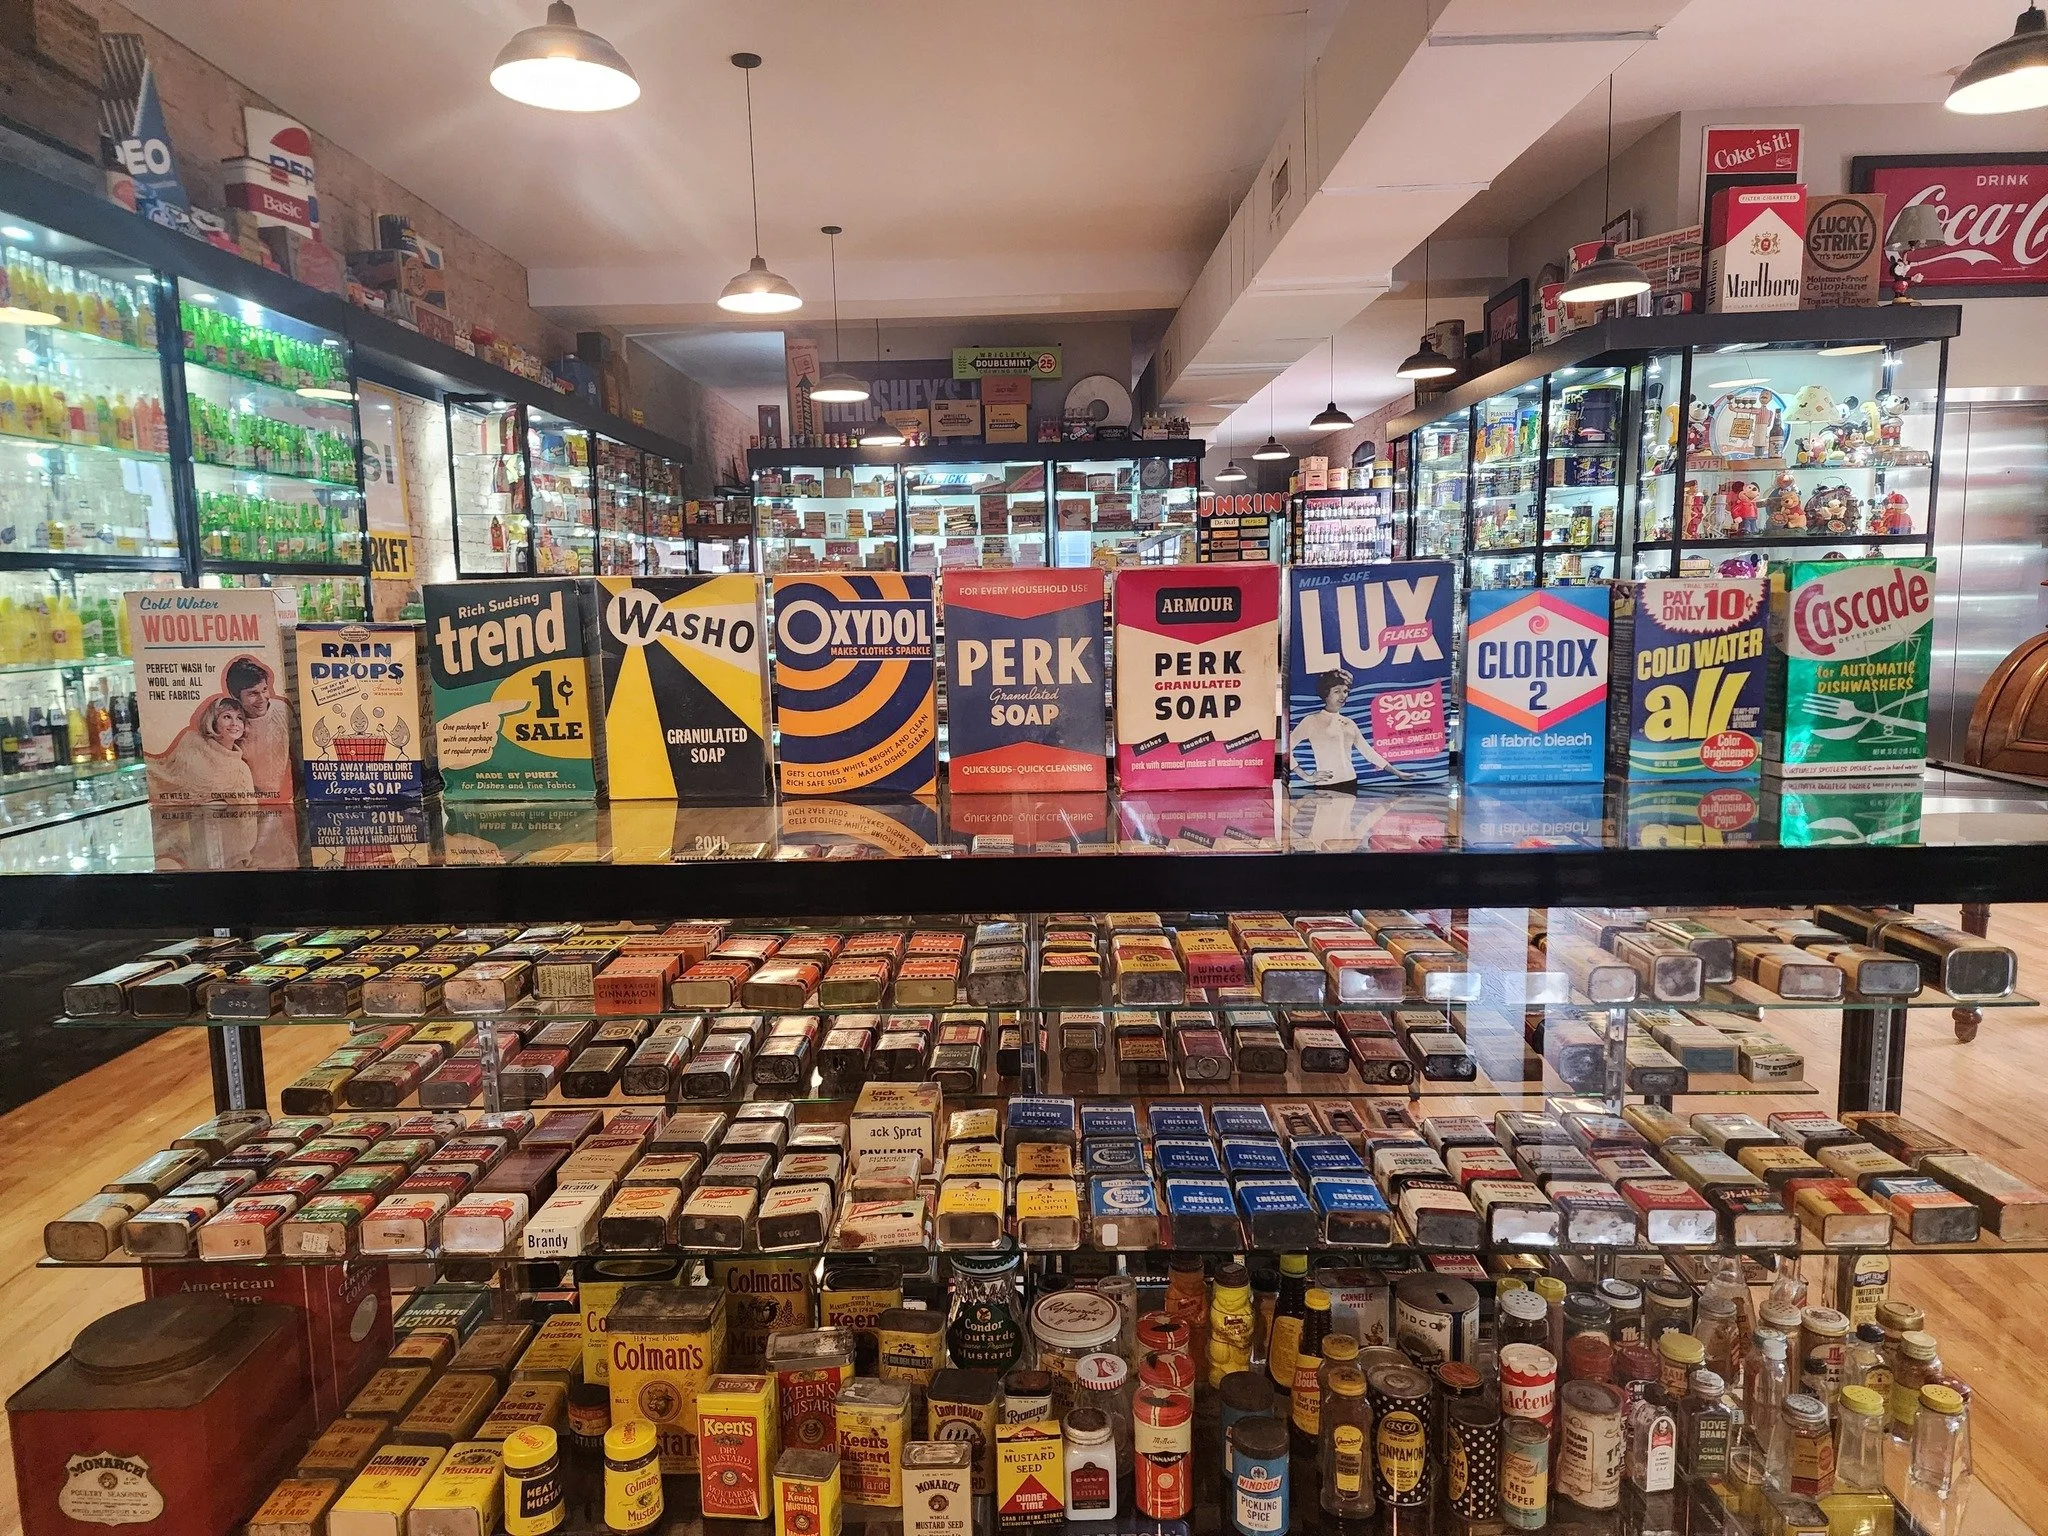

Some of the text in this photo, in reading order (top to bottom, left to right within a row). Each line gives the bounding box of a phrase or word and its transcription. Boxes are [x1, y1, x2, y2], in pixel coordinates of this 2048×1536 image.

[1714, 132, 1791, 169] Coke is it!
[1977, 175, 2029, 186] DRINK
[263, 194, 301, 219] Basic
[1816, 215, 1867, 234] LUCKY
[1812, 234, 1869, 252] STRIKE
[1726, 262, 1799, 299] Marlboro
[1806, 283, 1867, 292] Cellophane
[976, 359, 1031, 368] DOUBLEMINT
[1070, 427, 1088, 441] Crush
[959, 584, 1088, 595] FOR EVERY HOUSEHOLD USE
[140, 597, 220, 611] Cold Water
[458, 593, 539, 619] Rich Sudsing
[1161, 596, 1233, 614] ARMOUR
[1662, 591, 1693, 606] PAY
[1662, 606, 1705, 621] ONLY
[1794, 570, 1929, 658] Cascade
[141, 614, 260, 643] WOOLFOAM
[435, 591, 566, 674] trend
[618, 597, 755, 653] WASHO
[777, 600, 931, 655] OXYDOL
[1299, 576, 1444, 674] LUX
[1382, 627, 1430, 642] FLAKES
[1838, 625, 1892, 644] DETERGENT
[321, 643, 391, 657] RAIN
[831, 646, 931, 656] MAKES CLOTHES SPARKLE
[1637, 628, 1764, 682] COLD WATER
[957, 637, 1093, 686] PERK
[1155, 651, 1242, 676] PERK
[1478, 638, 1598, 680] CLOROX
[146, 663, 216, 674] PERFECT WASH for
[311, 663, 404, 679] DROPS
[1817, 661, 1914, 679] for AUTOMATIC
[147, 677, 203, 688] WOOL and ALL
[1155, 679, 1241, 690] GRANULATED
[1818, 678, 1914, 694] DISHWASHERS
[149, 690, 201, 701] FINE FABRICS
[989, 687, 1059, 702] Granulated
[1379, 691, 1436, 713] Save
[1529, 681, 1548, 711] 2
[1155, 695, 1241, 720] SOAP
[1643, 669, 1752, 742] all
[990, 704, 1059, 726] SOAP
[516, 722, 583, 741] SALE
[667, 728, 748, 744] GRANULATED
[786, 714, 928, 778] GETS CLOTHES WHITE, BRIGHT AND CLEAN
[1481, 733, 1592, 748] all fabric bleach
[1718, 735, 1741, 746] Color
[691, 748, 725, 763] SOAP
[858, 728, 930, 779] MAKES DISHES GLEAM
[1703, 746, 1754, 760] Brighteners
[311, 763, 412, 773] FLOATS AWAY HIDDEN DIRT
[476, 771, 558, 780] MADE BY PUREX
[312, 771, 413, 781] SAVES SEPARATE BLUING
[786, 777, 847, 787] RICH SAFE SUDS
[325, 781, 402, 796] Saves SOAP
[477, 781, 506, 789] Dishes
[566, 938, 622, 946] CAIN'S
[1198, 965, 1236, 973] WHOLE
[1193, 974, 1242, 984] NUTMEGS
[599, 990, 656, 998] CINNAMON
[774, 1186, 819, 1196] MARJORAM
[528, 1234, 568, 1249] Brandy
[180, 1278, 275, 1293] American
[727, 1267, 803, 1294] Colman's
[964, 1318, 1004, 1332] Condor
[613, 1342, 703, 1371] Colman's
[703, 1418, 753, 1437] Keen's
[1700, 1421, 1727, 1429] DOVE
[840, 1431, 889, 1448] Keen's
[1700, 1430, 1726, 1439] BRAND
[720, 1447, 738, 1455] DRY
[1004, 1452, 1055, 1463] MUSTARD
[371, 1456, 430, 1466] COLMAN'S
[707, 1454, 751, 1465] MUSTARD
[70, 1458, 146, 1478] MONARCH
[443, 1466, 495, 1475] Mustard
[1016, 1464, 1042, 1473] SEED
[526, 1480, 555, 1499] MEAT
[915, 1479, 960, 1493] MONARCH
[1239, 1476, 1279, 1491] WINDSOR
[1509, 1481, 1526, 1494] RED
[787, 1493, 815, 1503] Keen's
[1016, 1493, 1047, 1502] DINNER
[1241, 1496, 1277, 1510] PICKLING
[785, 1502, 817, 1514] MUSTARD
[1020, 1502, 1044, 1510] TIME
[1247, 1509, 1270, 1521] SPICE
[915, 1521, 945, 1529] MUSTARD
